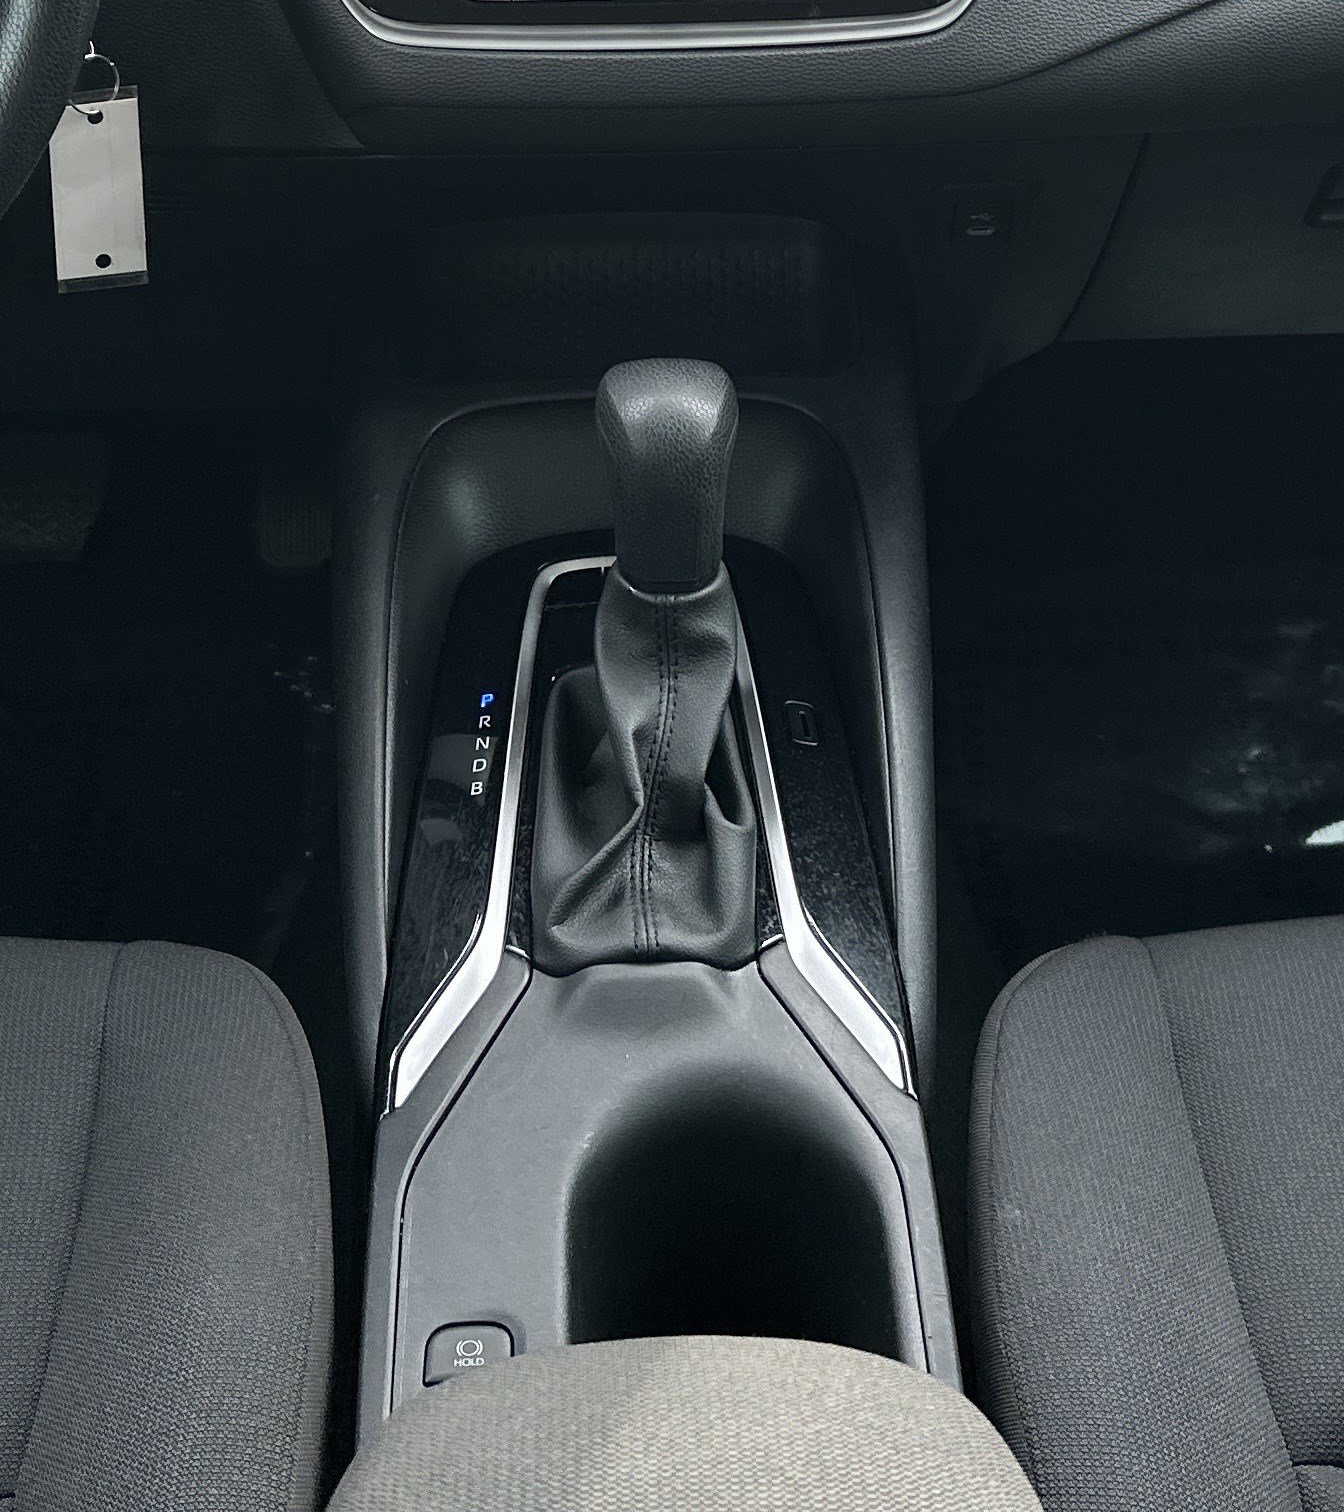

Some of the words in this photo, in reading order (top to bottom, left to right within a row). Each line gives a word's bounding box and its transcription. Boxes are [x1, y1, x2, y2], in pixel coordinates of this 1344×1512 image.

[480, 693, 494, 708] P
[478, 715, 491, 729] R
[475, 736, 490, 751] N
[472, 758, 487, 773] D
[470, 781, 483, 796] B
[453, 1357, 485, 1367] HOLD
